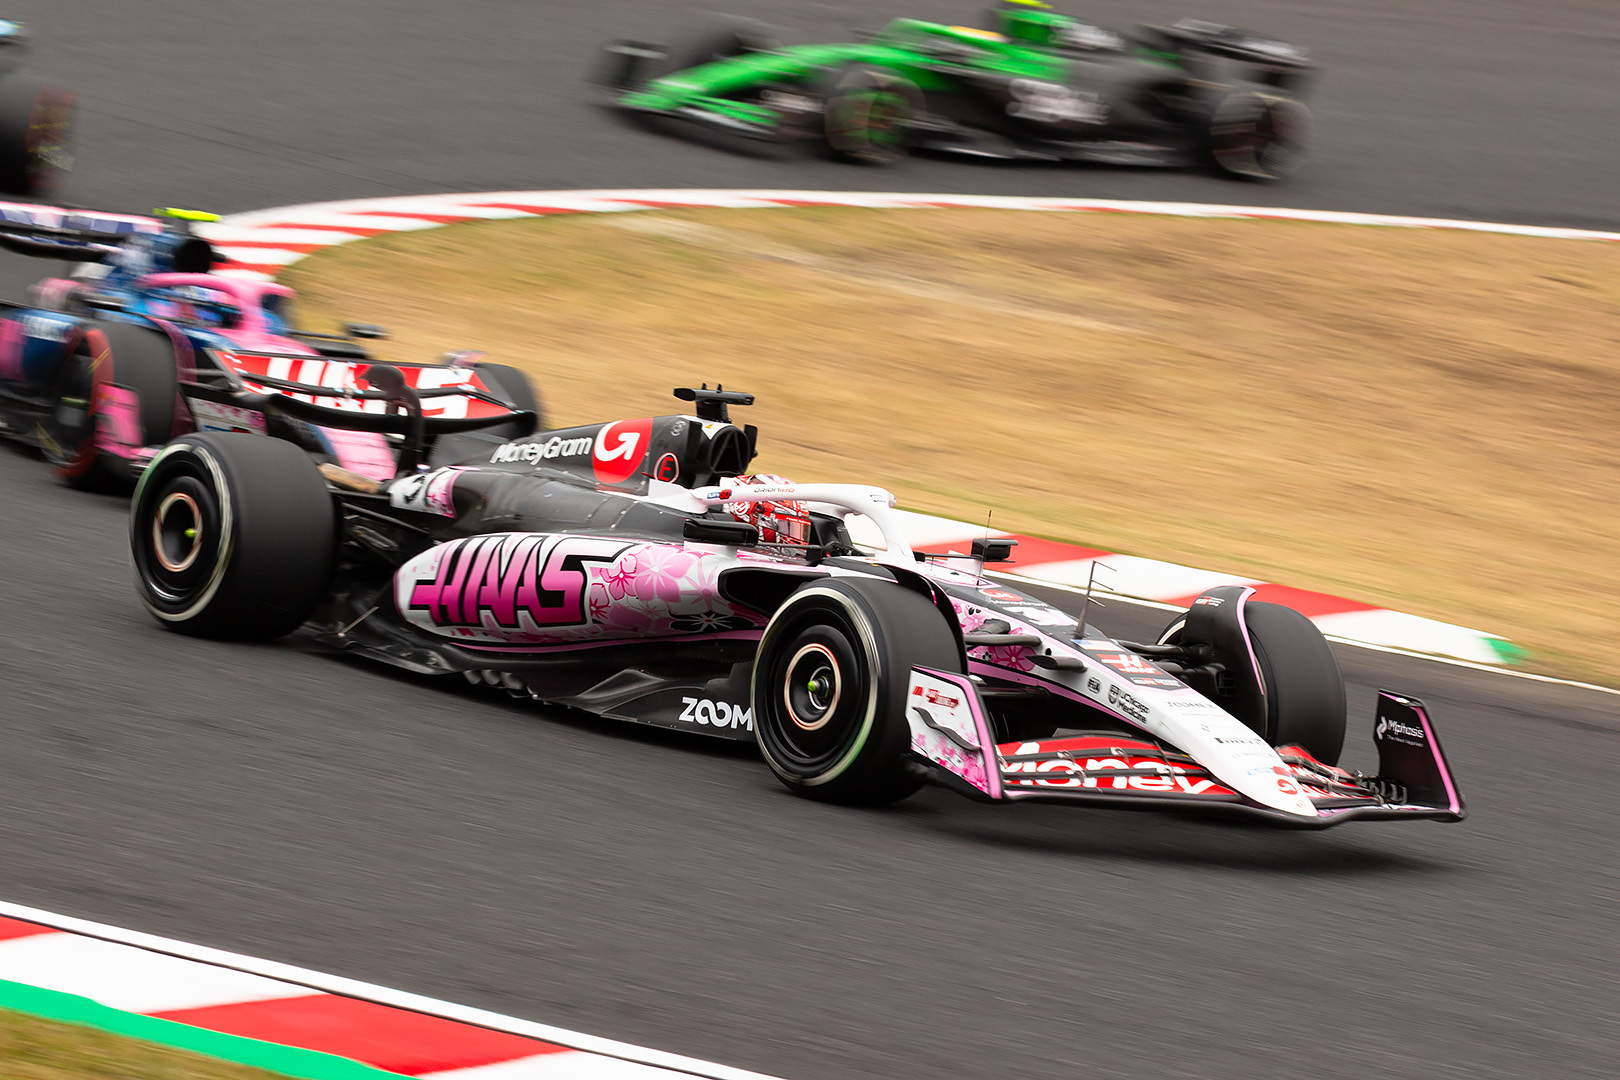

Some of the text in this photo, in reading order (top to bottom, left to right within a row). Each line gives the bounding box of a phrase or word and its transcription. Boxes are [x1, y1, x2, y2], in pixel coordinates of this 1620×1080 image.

[243, 357, 476, 420] HAS
[489, 436, 593, 465] MoneyGram
[658, 456, 674, 482] E
[409, 534, 638, 628] HAAS
[679, 697, 754, 732] ZOOM
[1118, 700, 1148, 725] Medicine
